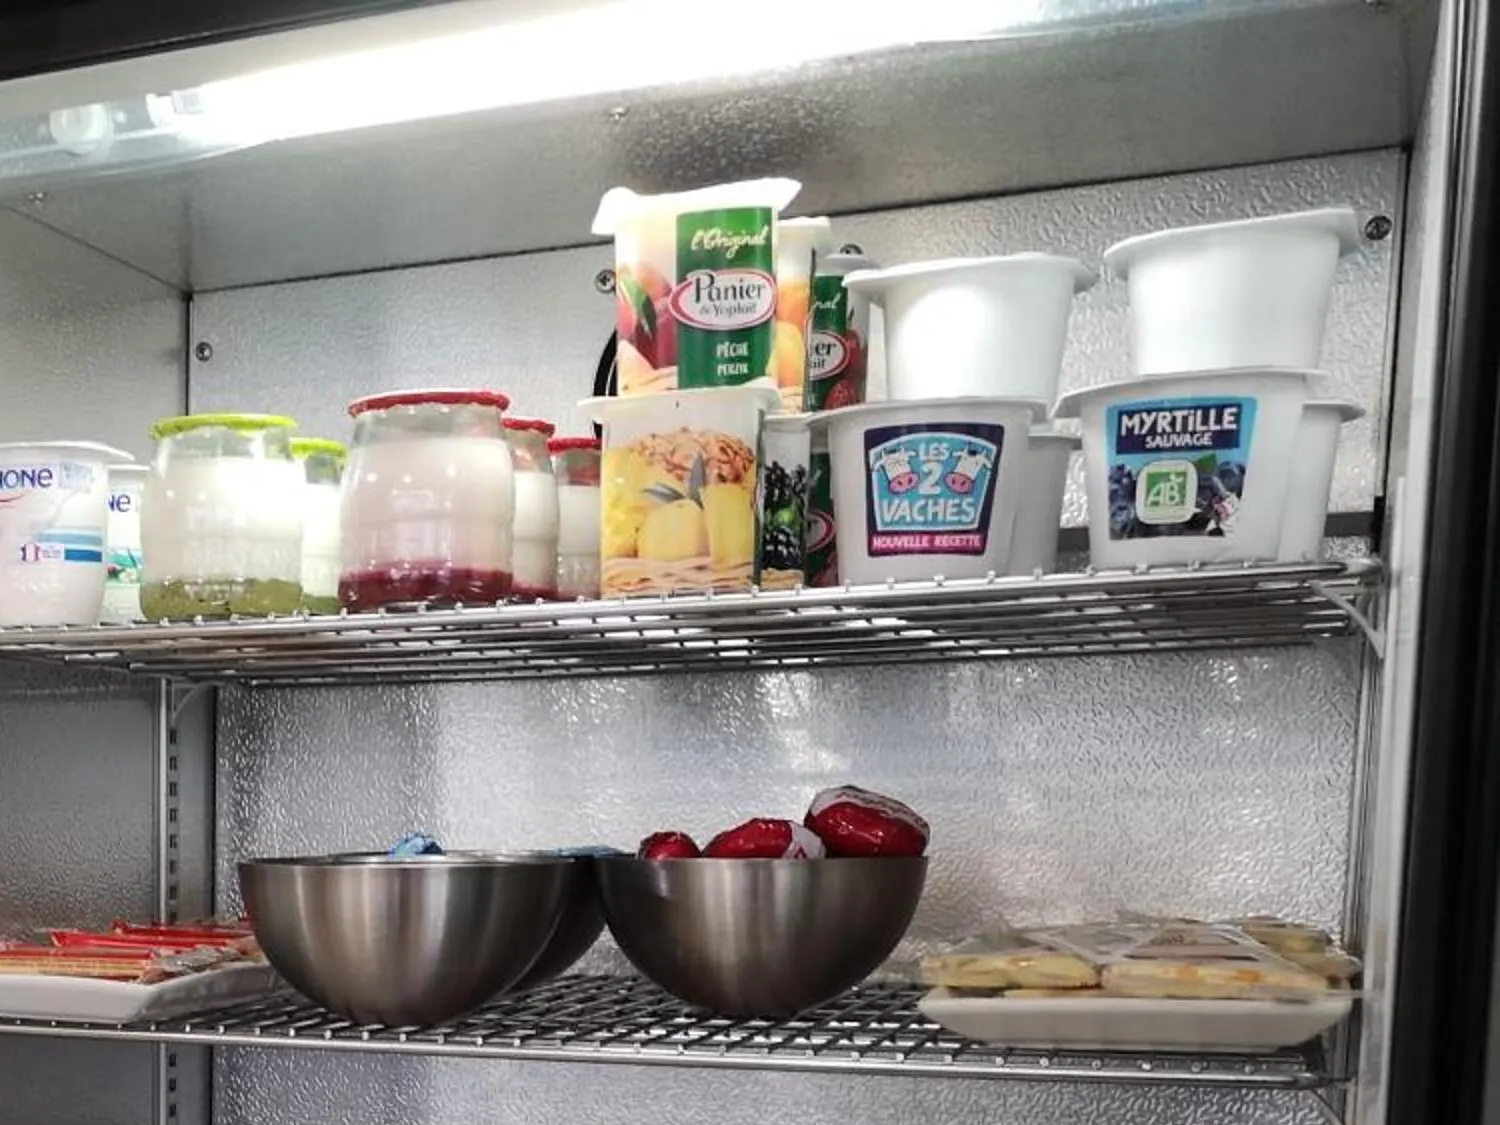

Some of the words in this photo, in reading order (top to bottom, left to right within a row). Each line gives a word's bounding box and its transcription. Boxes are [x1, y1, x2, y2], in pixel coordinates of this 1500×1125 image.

[693, 272, 766, 304] Panier
[713, 303, 757, 318] Yoplait
[1144, 432, 1213, 449] SAUVAGE
[919, 442, 950, 461] LES
[918, 461, 944, 496] 2
[882, 499, 975, 523] VACHES
